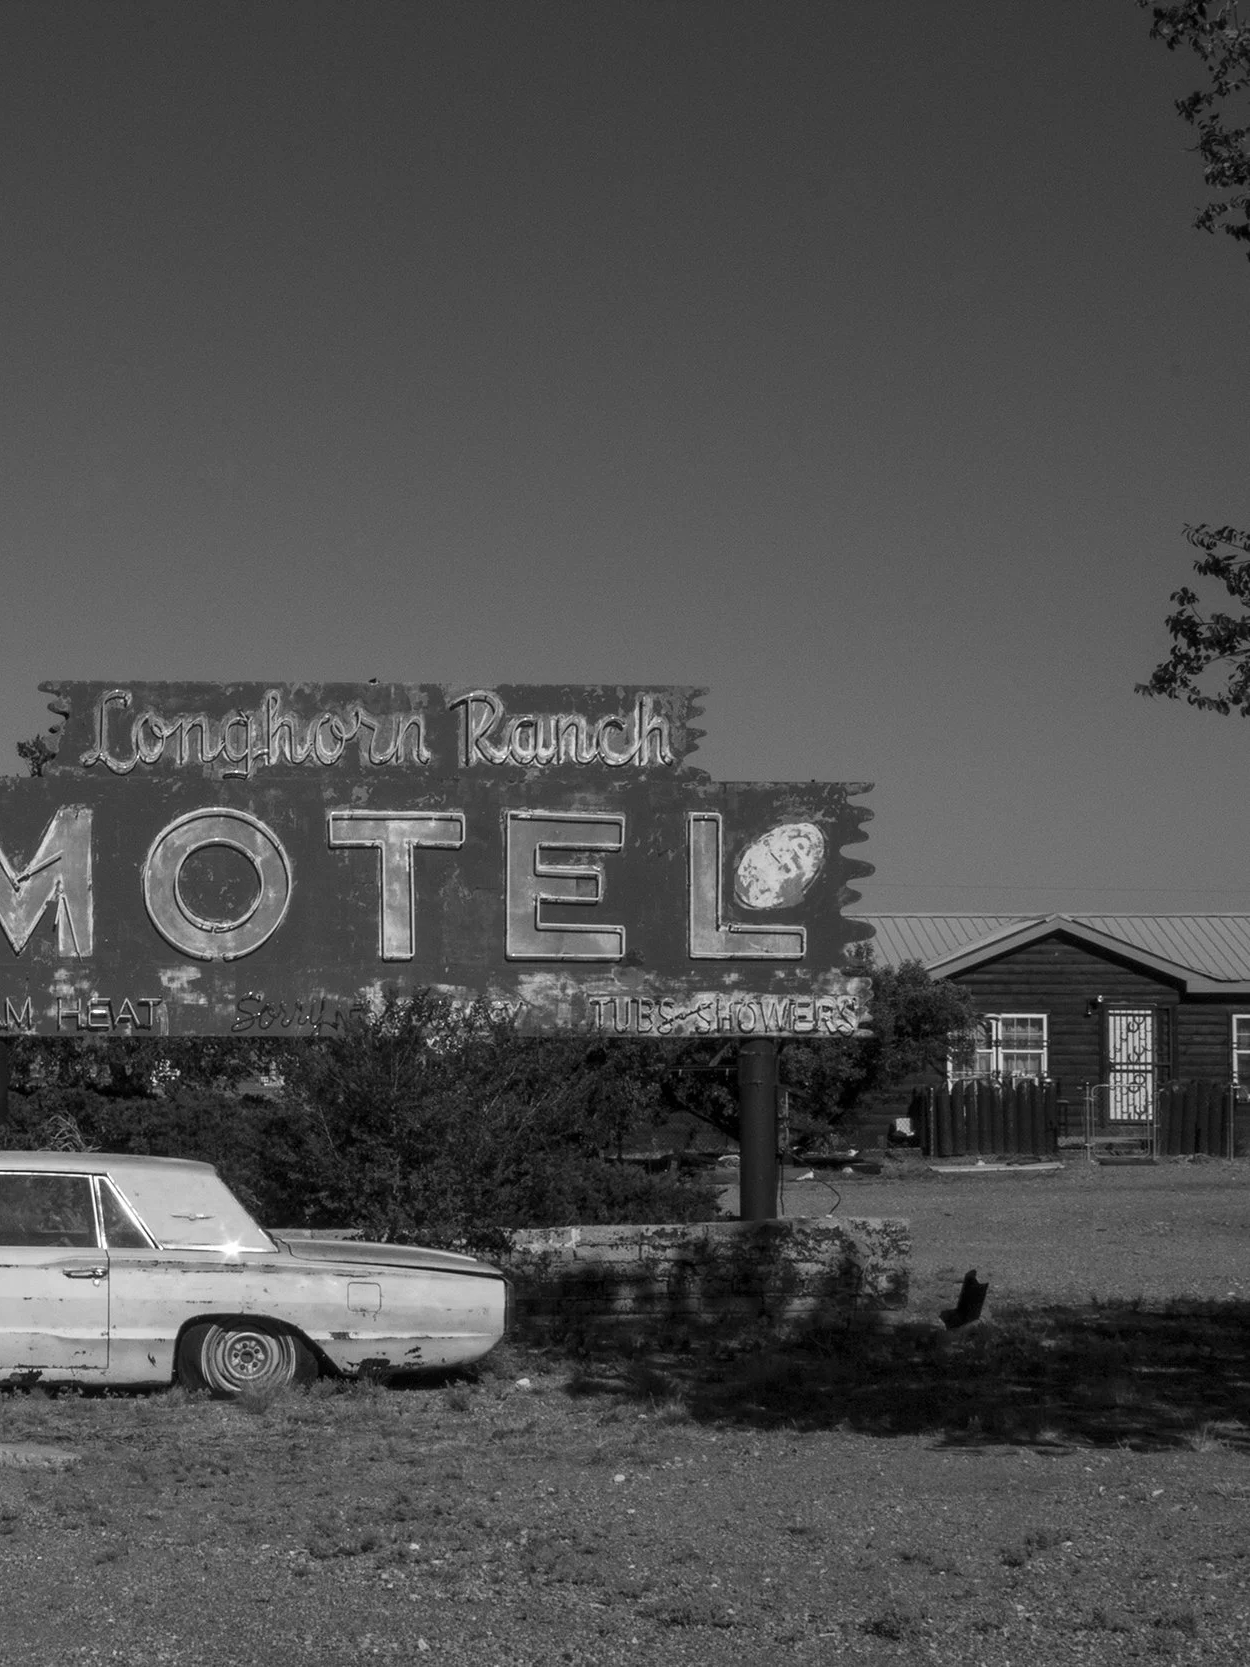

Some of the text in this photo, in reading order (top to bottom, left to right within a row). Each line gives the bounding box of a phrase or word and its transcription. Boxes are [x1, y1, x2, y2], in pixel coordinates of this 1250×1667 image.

[80, 688, 675, 780] Longhorn Ranch
[56, 995, 164, 1032] HEAT
[588, 995, 859, 1038] TUBS SHOWERS
